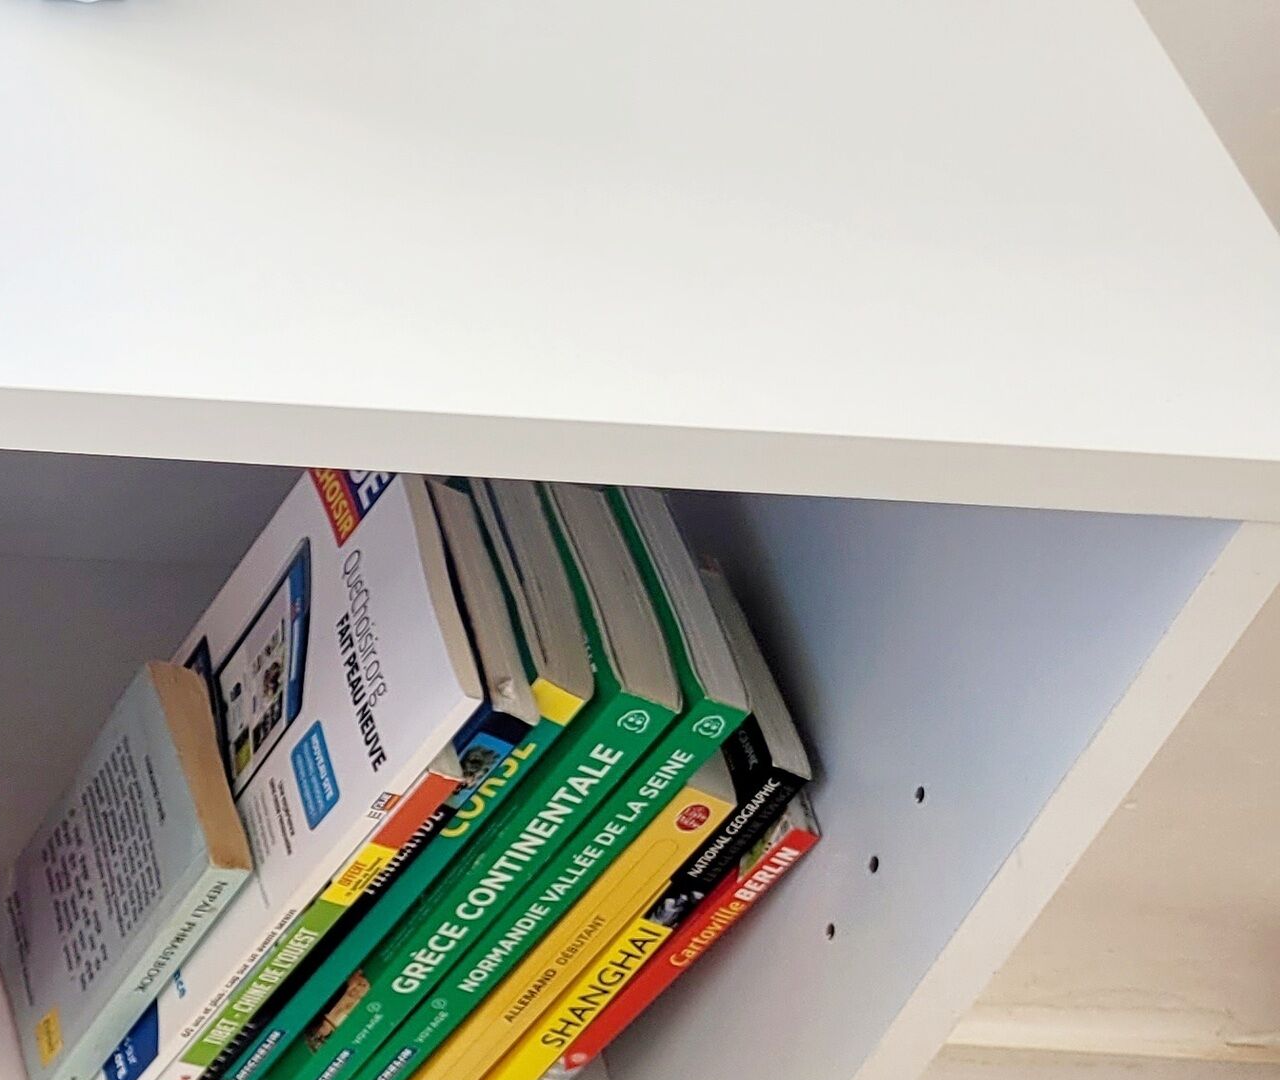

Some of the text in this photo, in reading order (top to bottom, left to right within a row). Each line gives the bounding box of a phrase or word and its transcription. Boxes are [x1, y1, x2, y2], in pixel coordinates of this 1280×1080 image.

[336, 611, 355, 656] FAIT
[343, 654, 366, 706] PEAU
[356, 701, 387, 772] NEUVE
[392, 920, 470, 995] GRÈCE
[455, 742, 624, 921] CONTINENTALE
[457, 902, 550, 993] NORMANDIE
[540, 844, 605, 904] VALLÉE
[600, 820, 627, 848] DE
[622, 800, 649, 824] LA
[639, 748, 695, 799] SEINE
[687, 836, 732, 878] NATIONAL
[725, 777, 781, 837] GEOGRAPHIC
[134, 881, 228, 992] NEPALI PHRASEBOOK
[271, 926, 319, 970] L'OUEST
[669, 846, 801, 967] Cartoville BERLIN
[232, 981, 272, 1014] CHINE
[258, 966, 285, 984] DE
[503, 968, 557, 1023] ALLEMAND
[556, 914, 608, 966] DÉBUTANT
[542, 926, 663, 1049] SHANGHAI
[202, 1017, 239, 1046] TIBET
